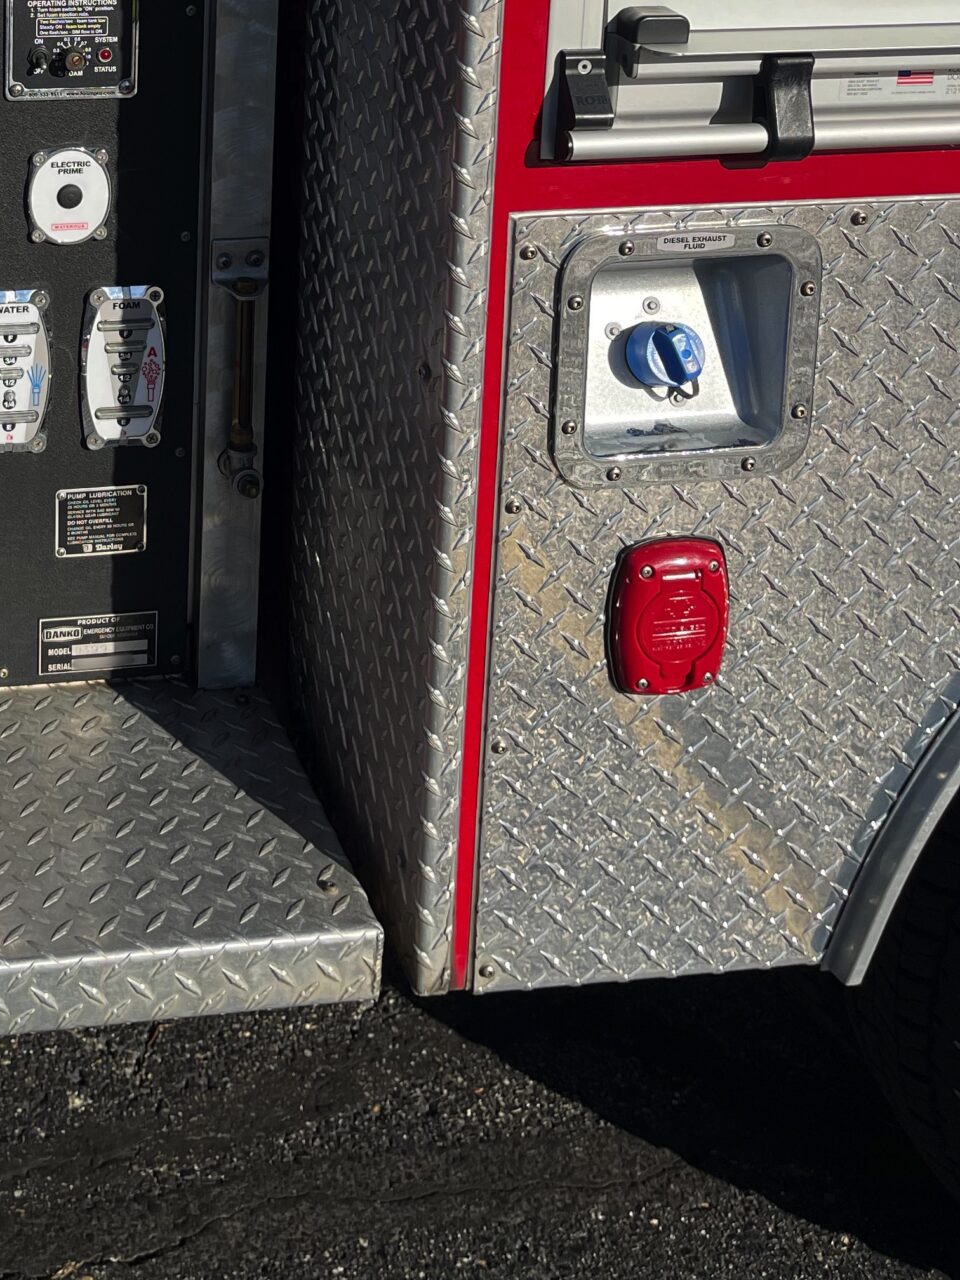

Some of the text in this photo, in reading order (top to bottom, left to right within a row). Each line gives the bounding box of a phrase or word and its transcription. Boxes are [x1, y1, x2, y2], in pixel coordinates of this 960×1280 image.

[112, 302, 140, 310] FOAM
[148, 347, 157, 357] A
[89, 490, 132, 498] LUBRICATION
[46, 629, 79, 639] DANKO
[48, 648, 71, 656] MODEL
[48, 663, 71, 671] SERIAL
